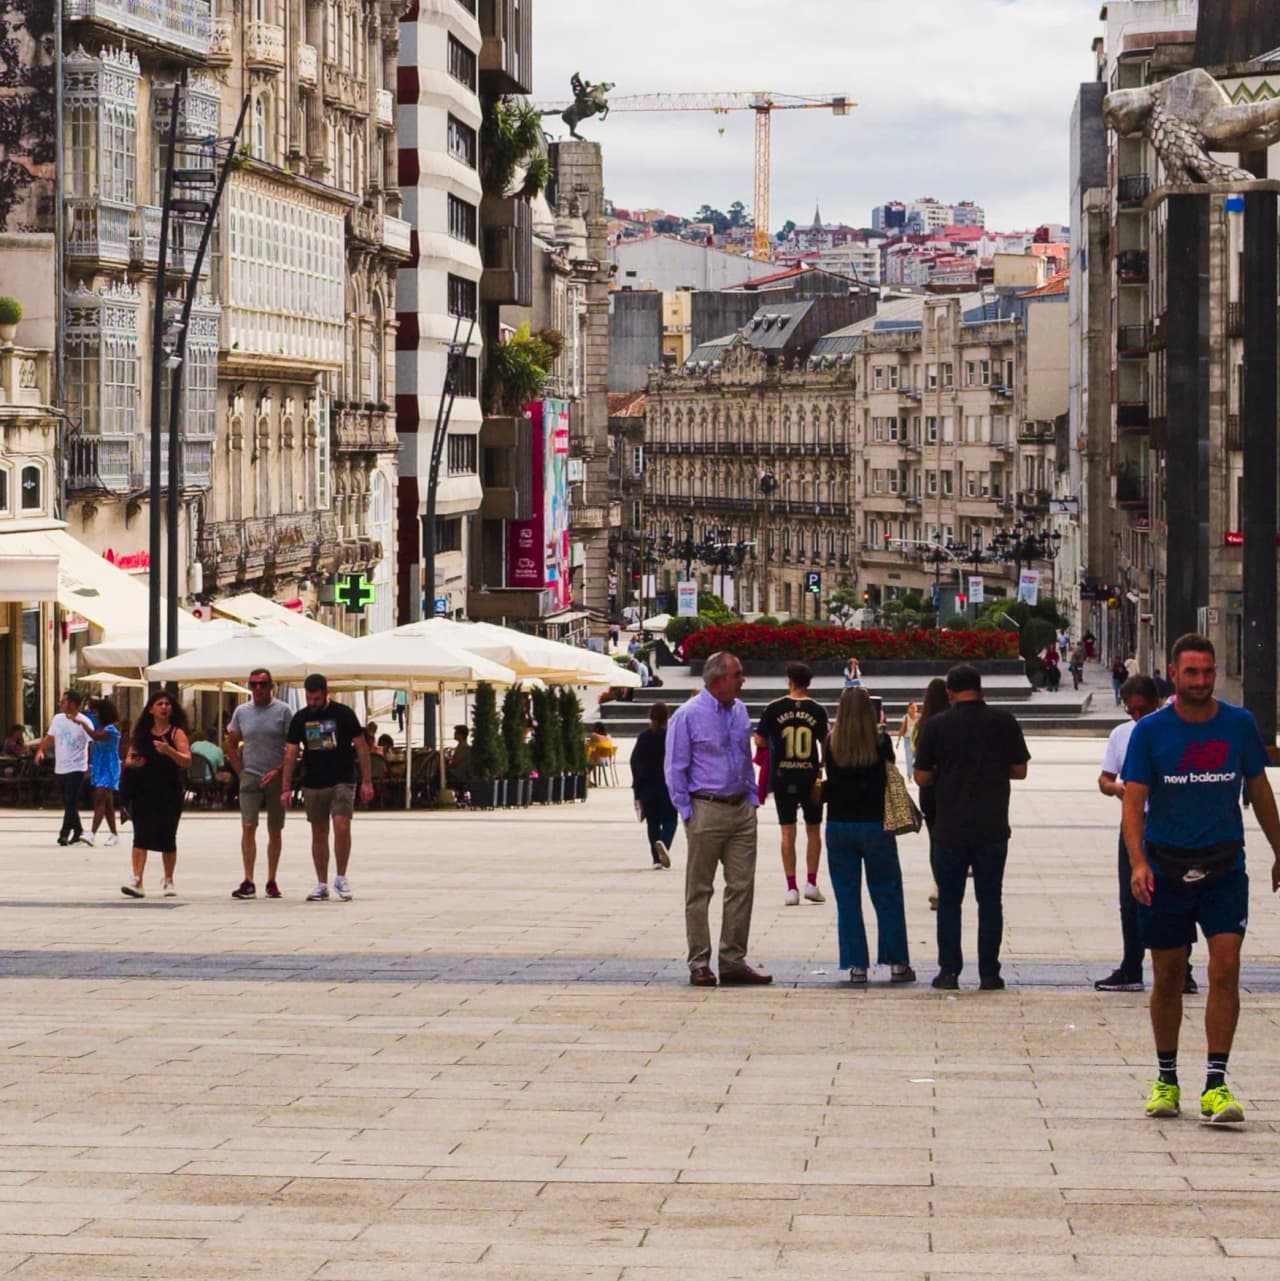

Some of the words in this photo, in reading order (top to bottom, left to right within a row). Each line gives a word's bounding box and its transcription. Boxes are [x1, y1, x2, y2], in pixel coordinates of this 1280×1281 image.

[809, 574, 818, 585] P
[783, 726, 813, 759] 10
[1163, 775, 1189, 784] new
